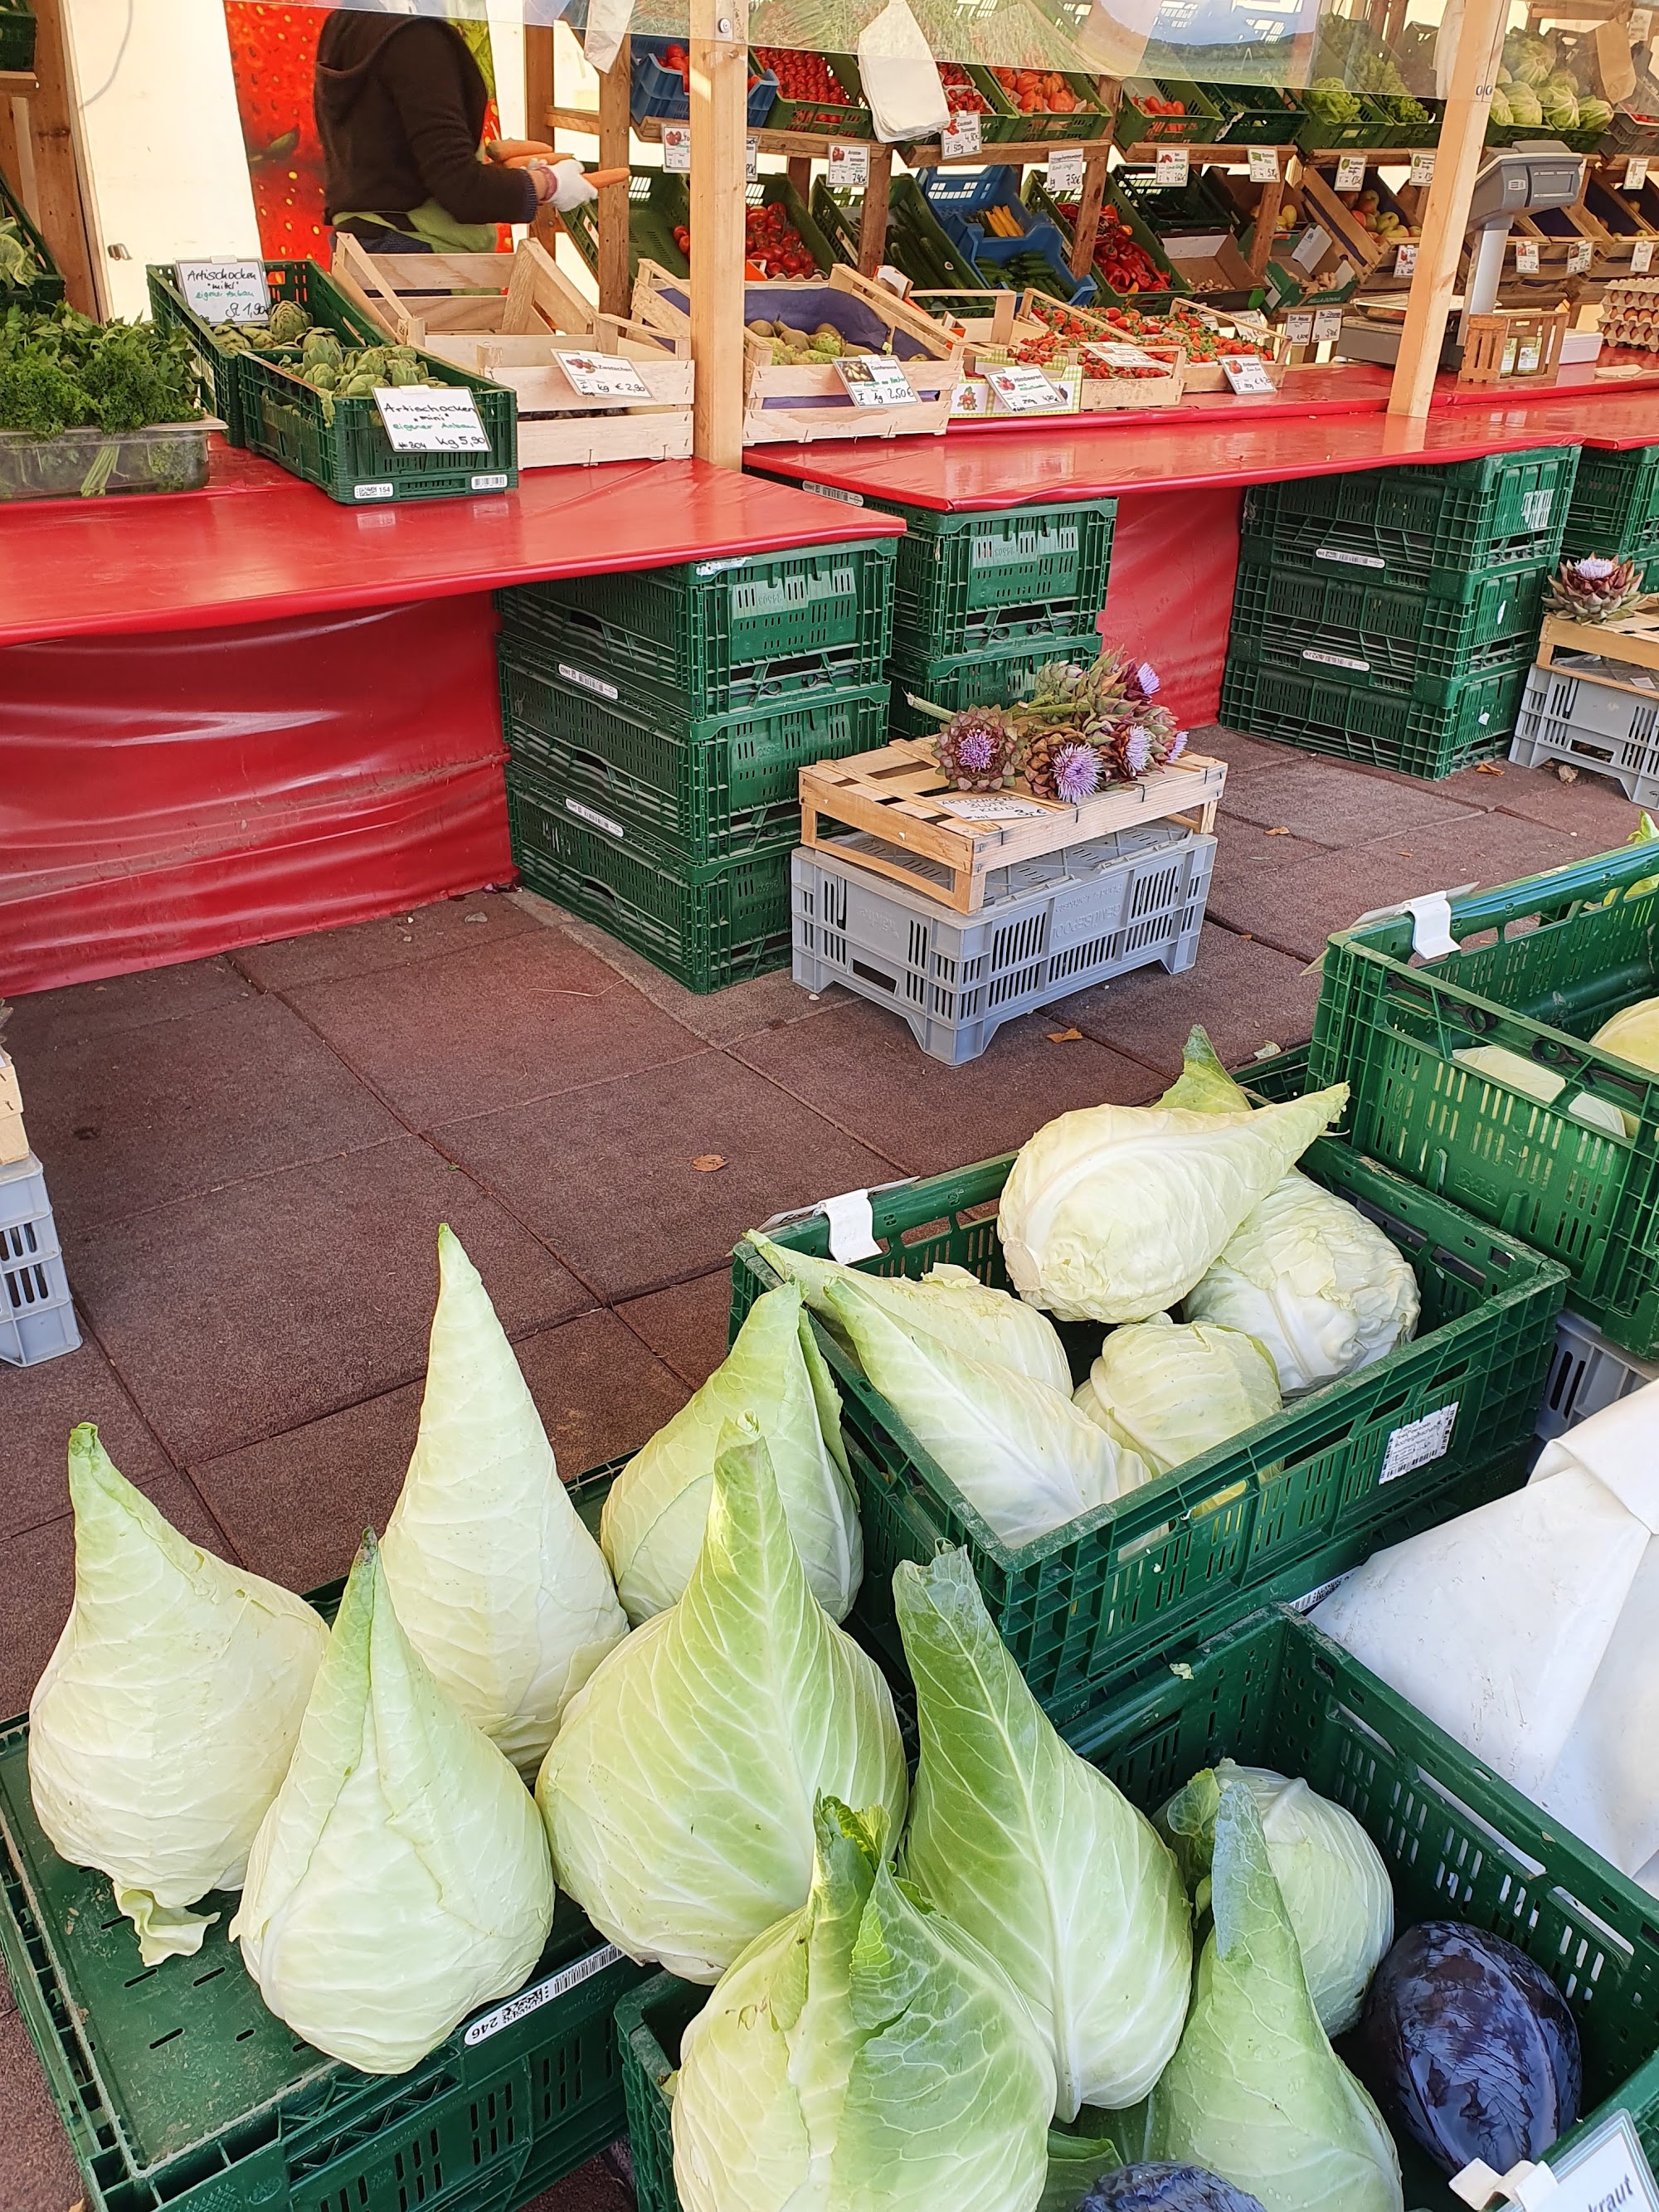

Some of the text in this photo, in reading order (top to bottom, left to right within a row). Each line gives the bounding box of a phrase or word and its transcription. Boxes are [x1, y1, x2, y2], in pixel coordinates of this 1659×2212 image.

[187, 267, 257, 281] Artischocken
[596, 382, 611, 393] kg
[625, 383, 645, 393] 2,90
[873, 391, 884, 404] kg
[383, 403, 479, 414] Artischocken
[392, 423, 434, 432] eigener
[435, 435, 460, 450] kg
[458, 435, 486, 448] 5,90
[471, 2015, 499, 2039] 246
